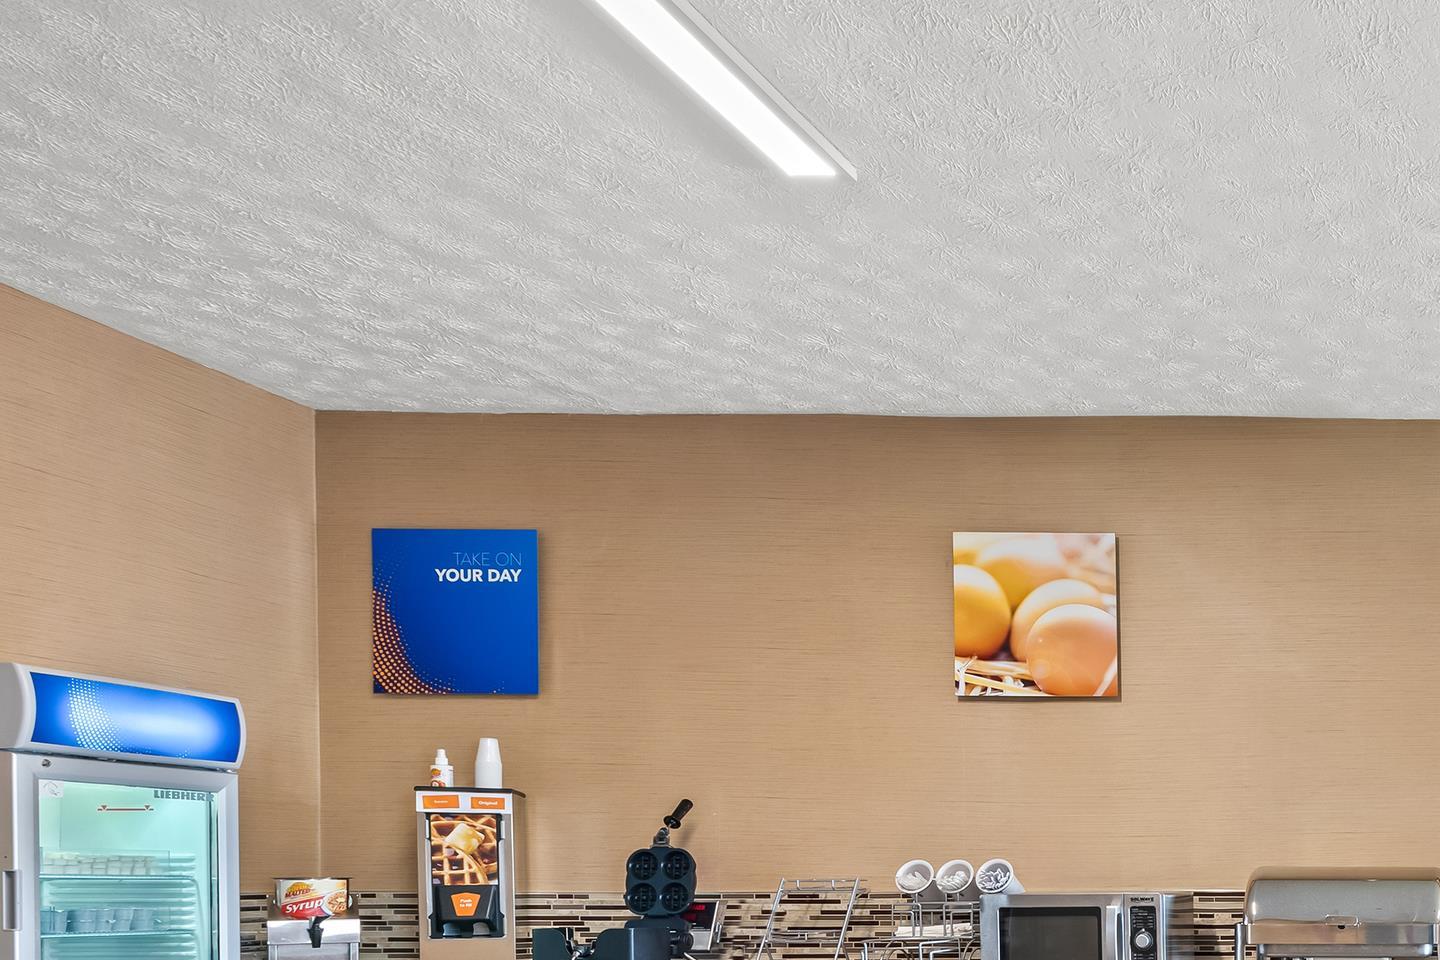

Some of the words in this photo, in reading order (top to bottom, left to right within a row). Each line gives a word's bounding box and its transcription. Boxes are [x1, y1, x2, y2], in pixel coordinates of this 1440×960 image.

[452, 551, 491, 567] TAKE
[495, 551, 522, 567] ON
[434, 568, 483, 583] YOUR
[487, 568, 522, 583] DAY
[153, 789, 215, 802] LIEBHERR
[285, 899, 324, 914] Syrup
